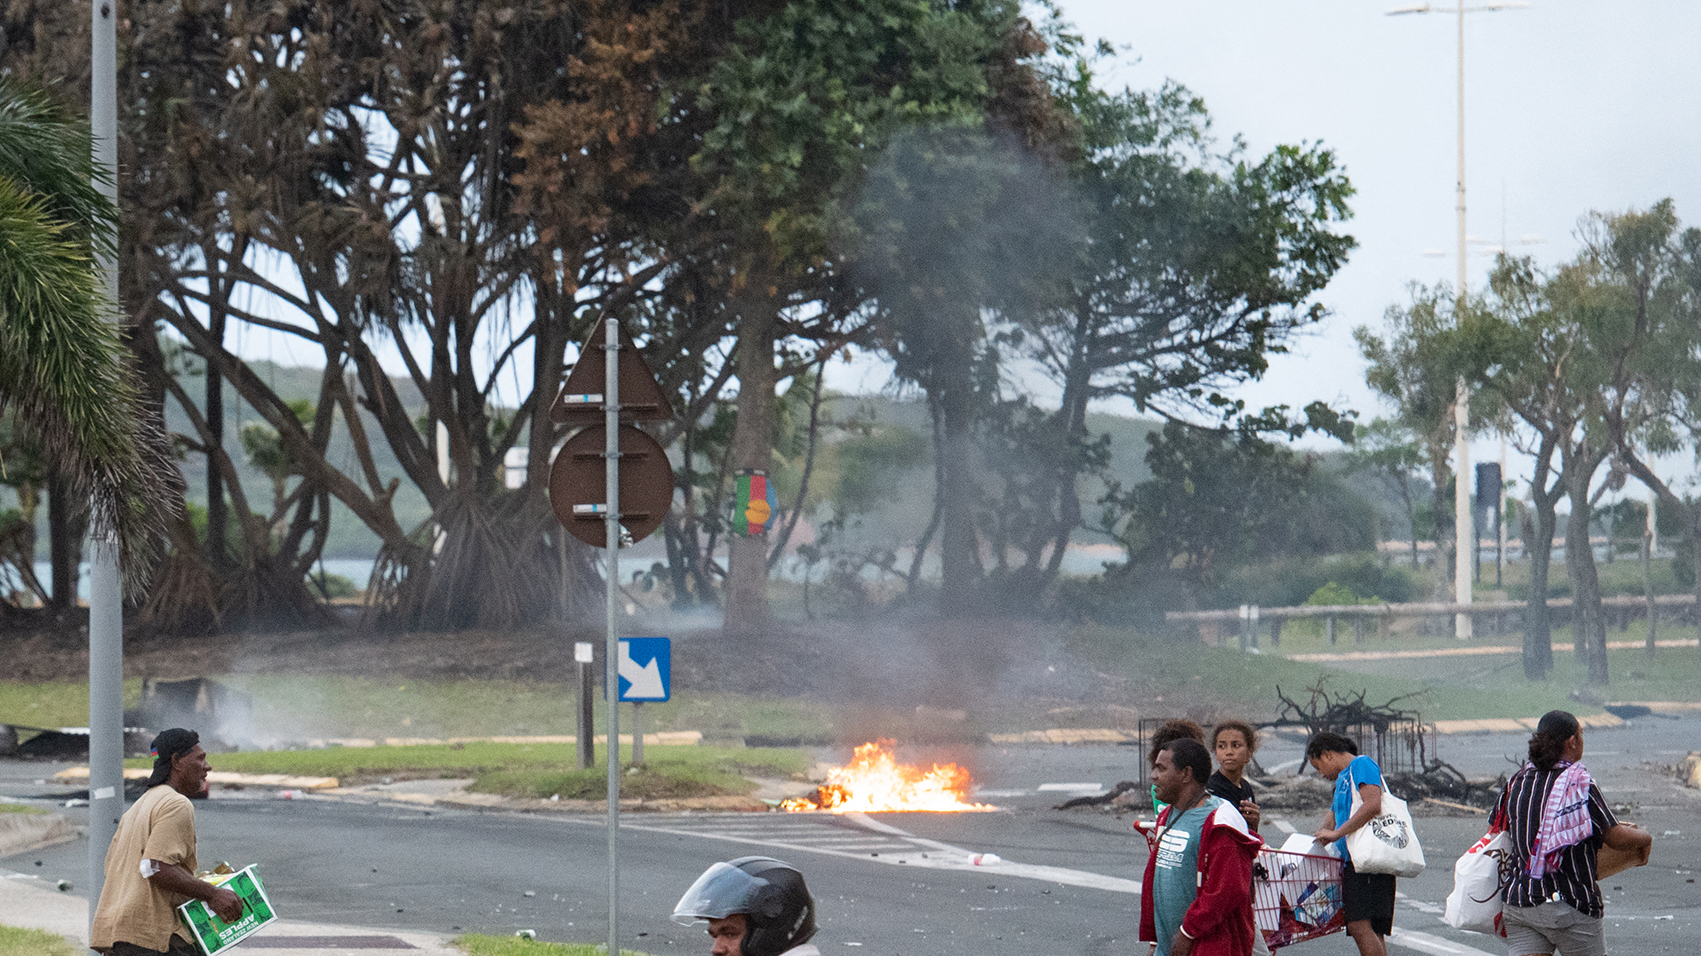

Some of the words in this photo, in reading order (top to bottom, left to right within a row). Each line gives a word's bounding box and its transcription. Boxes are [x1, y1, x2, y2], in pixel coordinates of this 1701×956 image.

[219, 913, 255, 940] APPLES
[246, 920, 259, 931] NEW
[222, 928, 246, 945] ZEALAND
